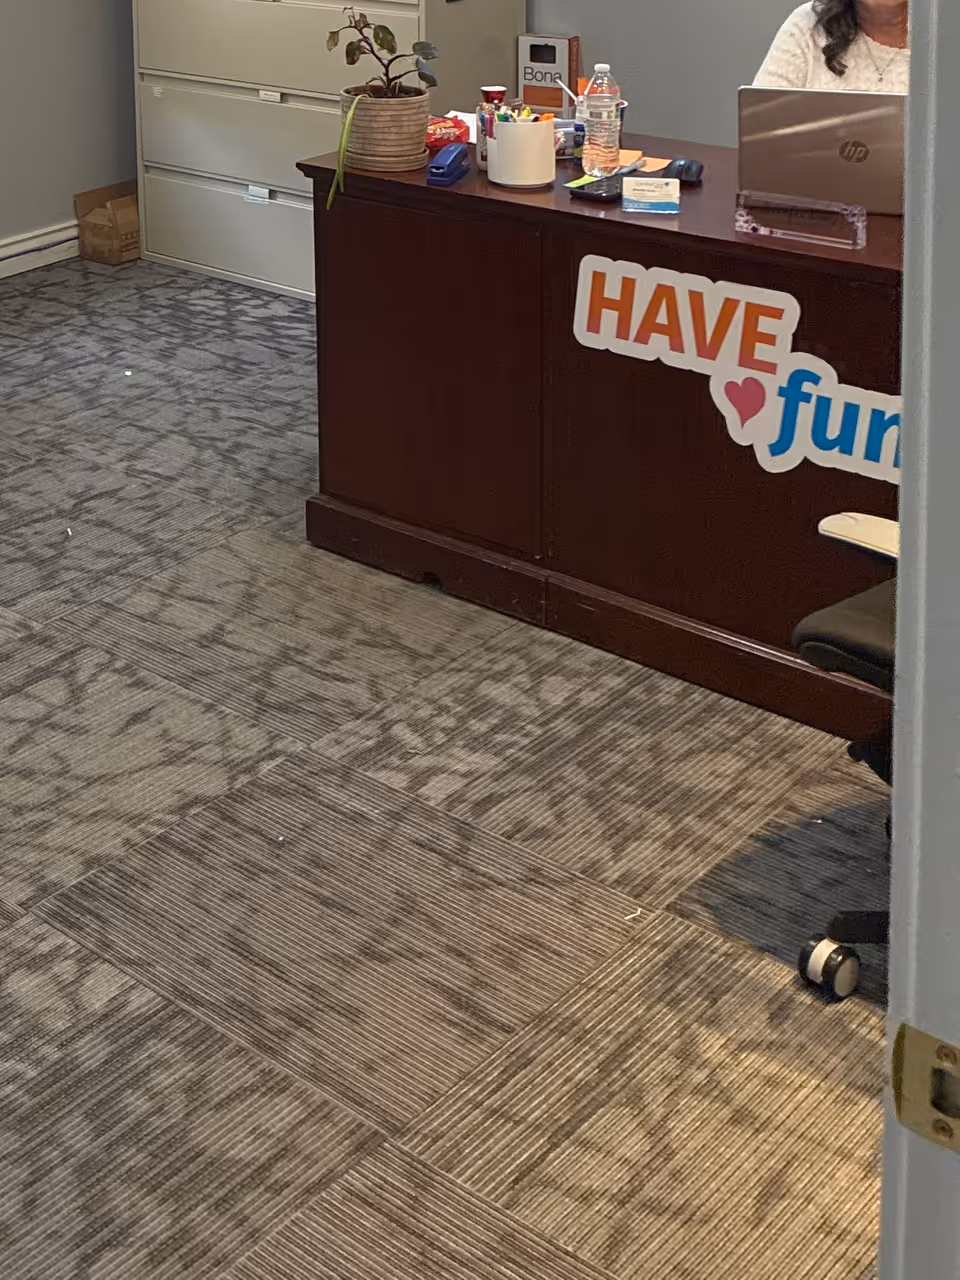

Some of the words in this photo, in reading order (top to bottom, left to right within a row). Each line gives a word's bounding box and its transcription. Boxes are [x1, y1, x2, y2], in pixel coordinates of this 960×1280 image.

[523, 66, 562, 83] Bona
[842, 140, 867, 163] hp
[586, 270, 785, 376] HAVE
[768, 368, 902, 469] fun
